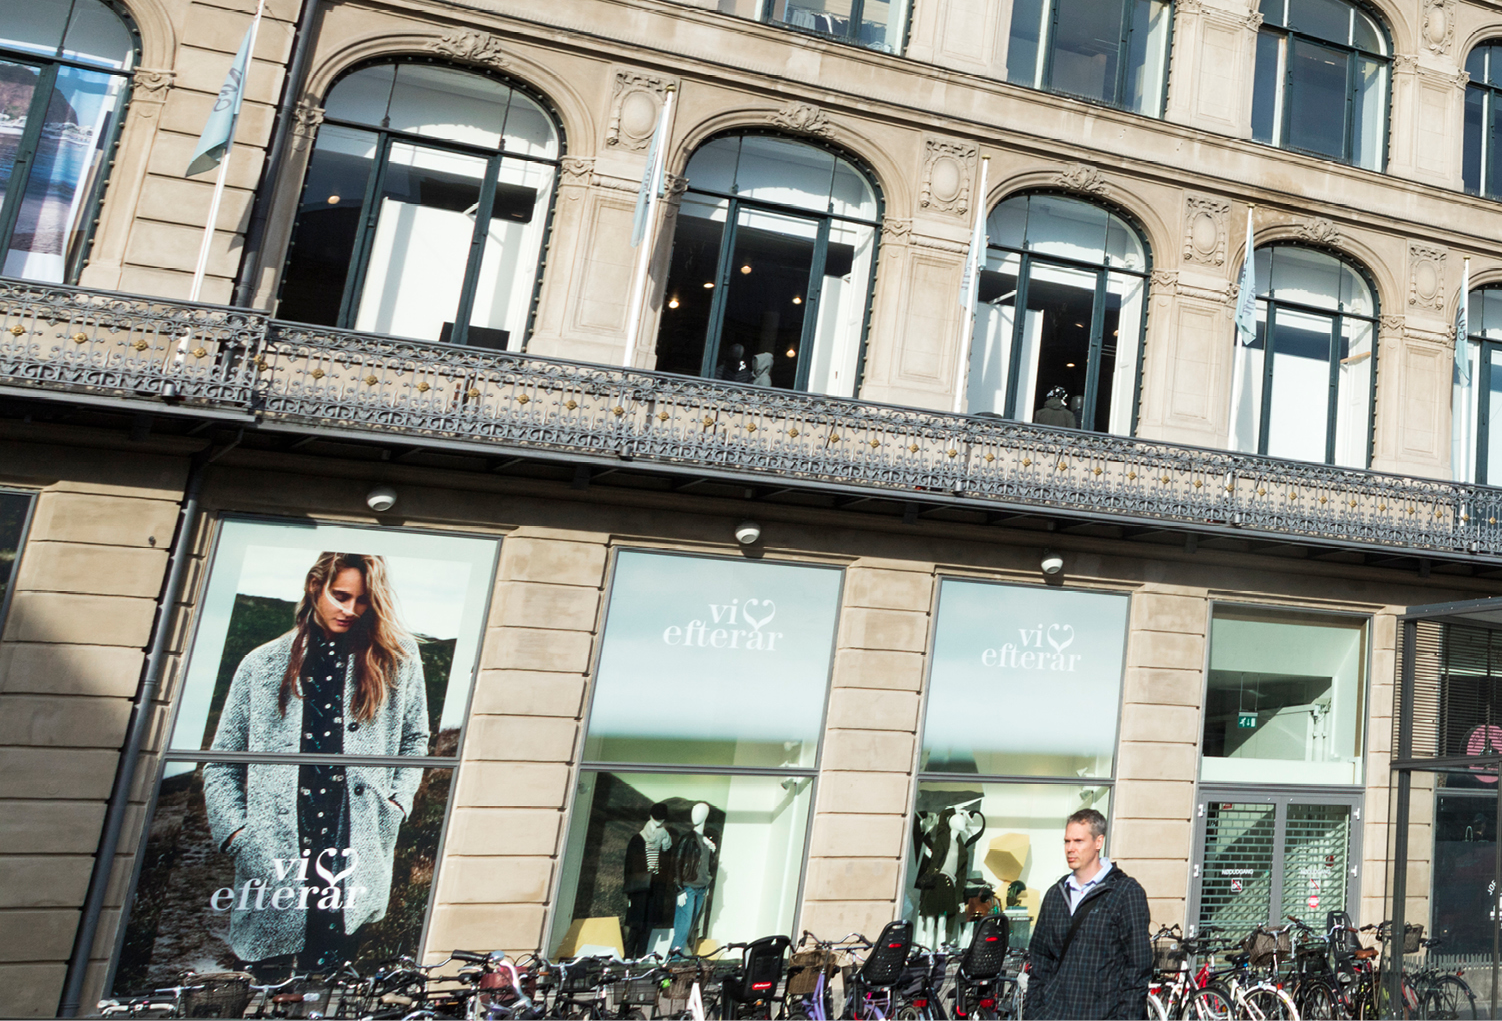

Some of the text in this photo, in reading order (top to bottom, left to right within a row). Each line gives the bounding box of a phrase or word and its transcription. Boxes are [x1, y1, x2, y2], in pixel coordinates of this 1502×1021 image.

[708, 598, 740, 625] vi
[1018, 623, 1044, 648] vi
[272, 847, 312, 881] vi
